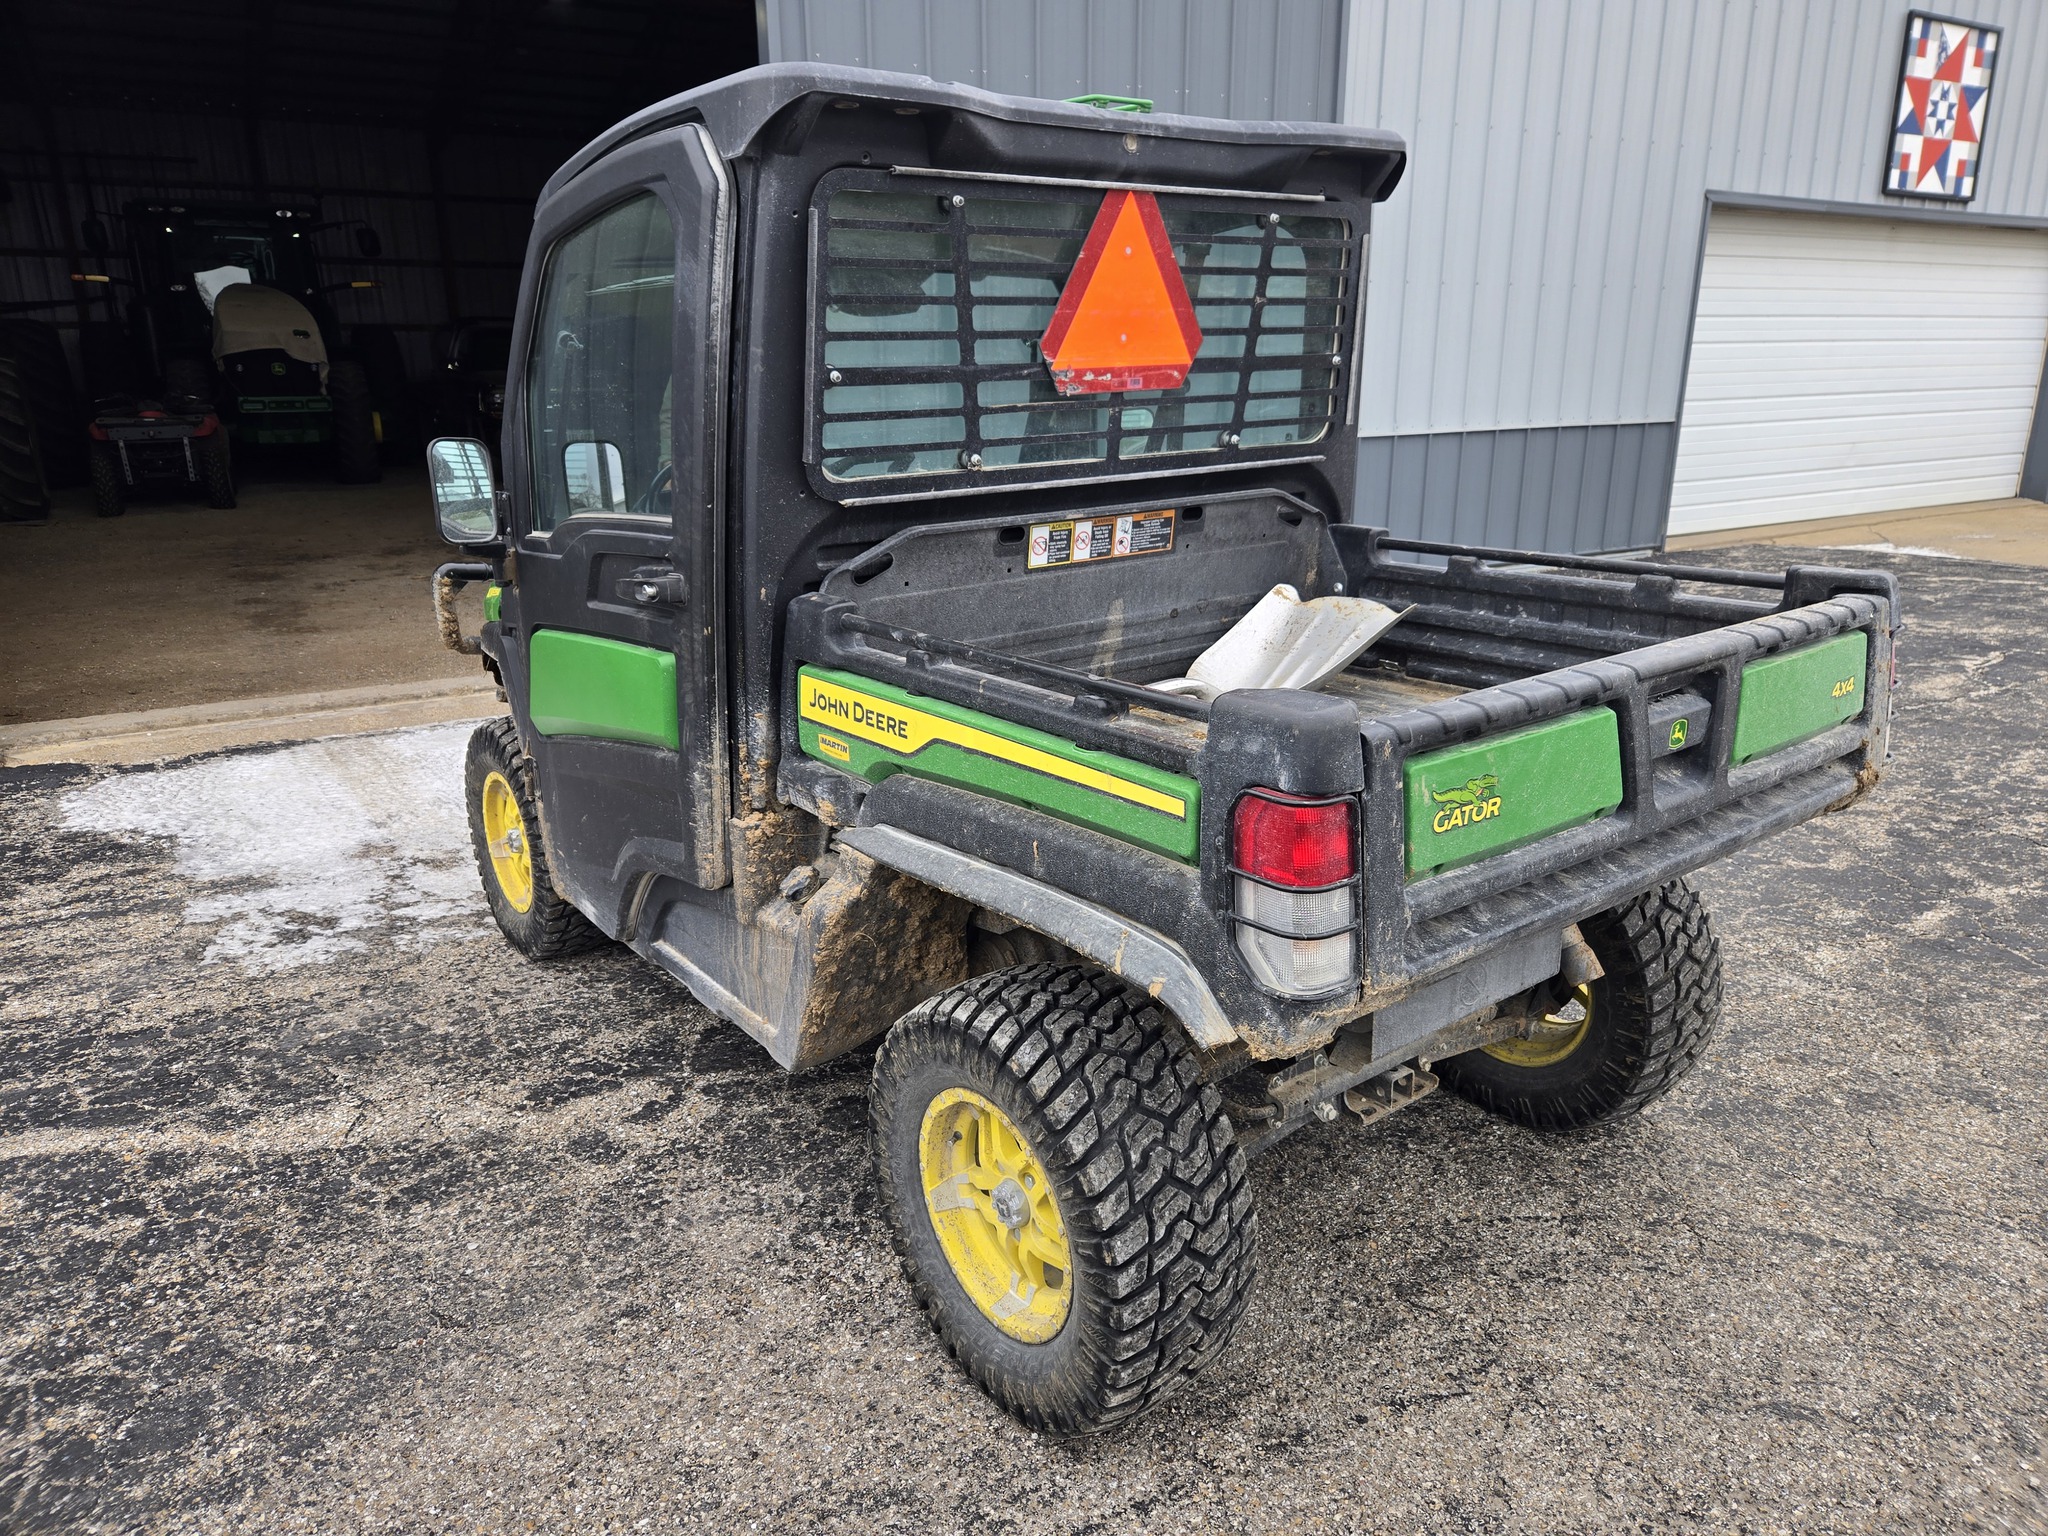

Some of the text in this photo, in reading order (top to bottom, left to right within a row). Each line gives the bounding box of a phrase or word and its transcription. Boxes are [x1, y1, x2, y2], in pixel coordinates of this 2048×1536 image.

[809, 688, 908, 740] JOHN DEERE
[820, 736, 848, 754] MARTIN
[1433, 796, 1502, 834] GATOR
